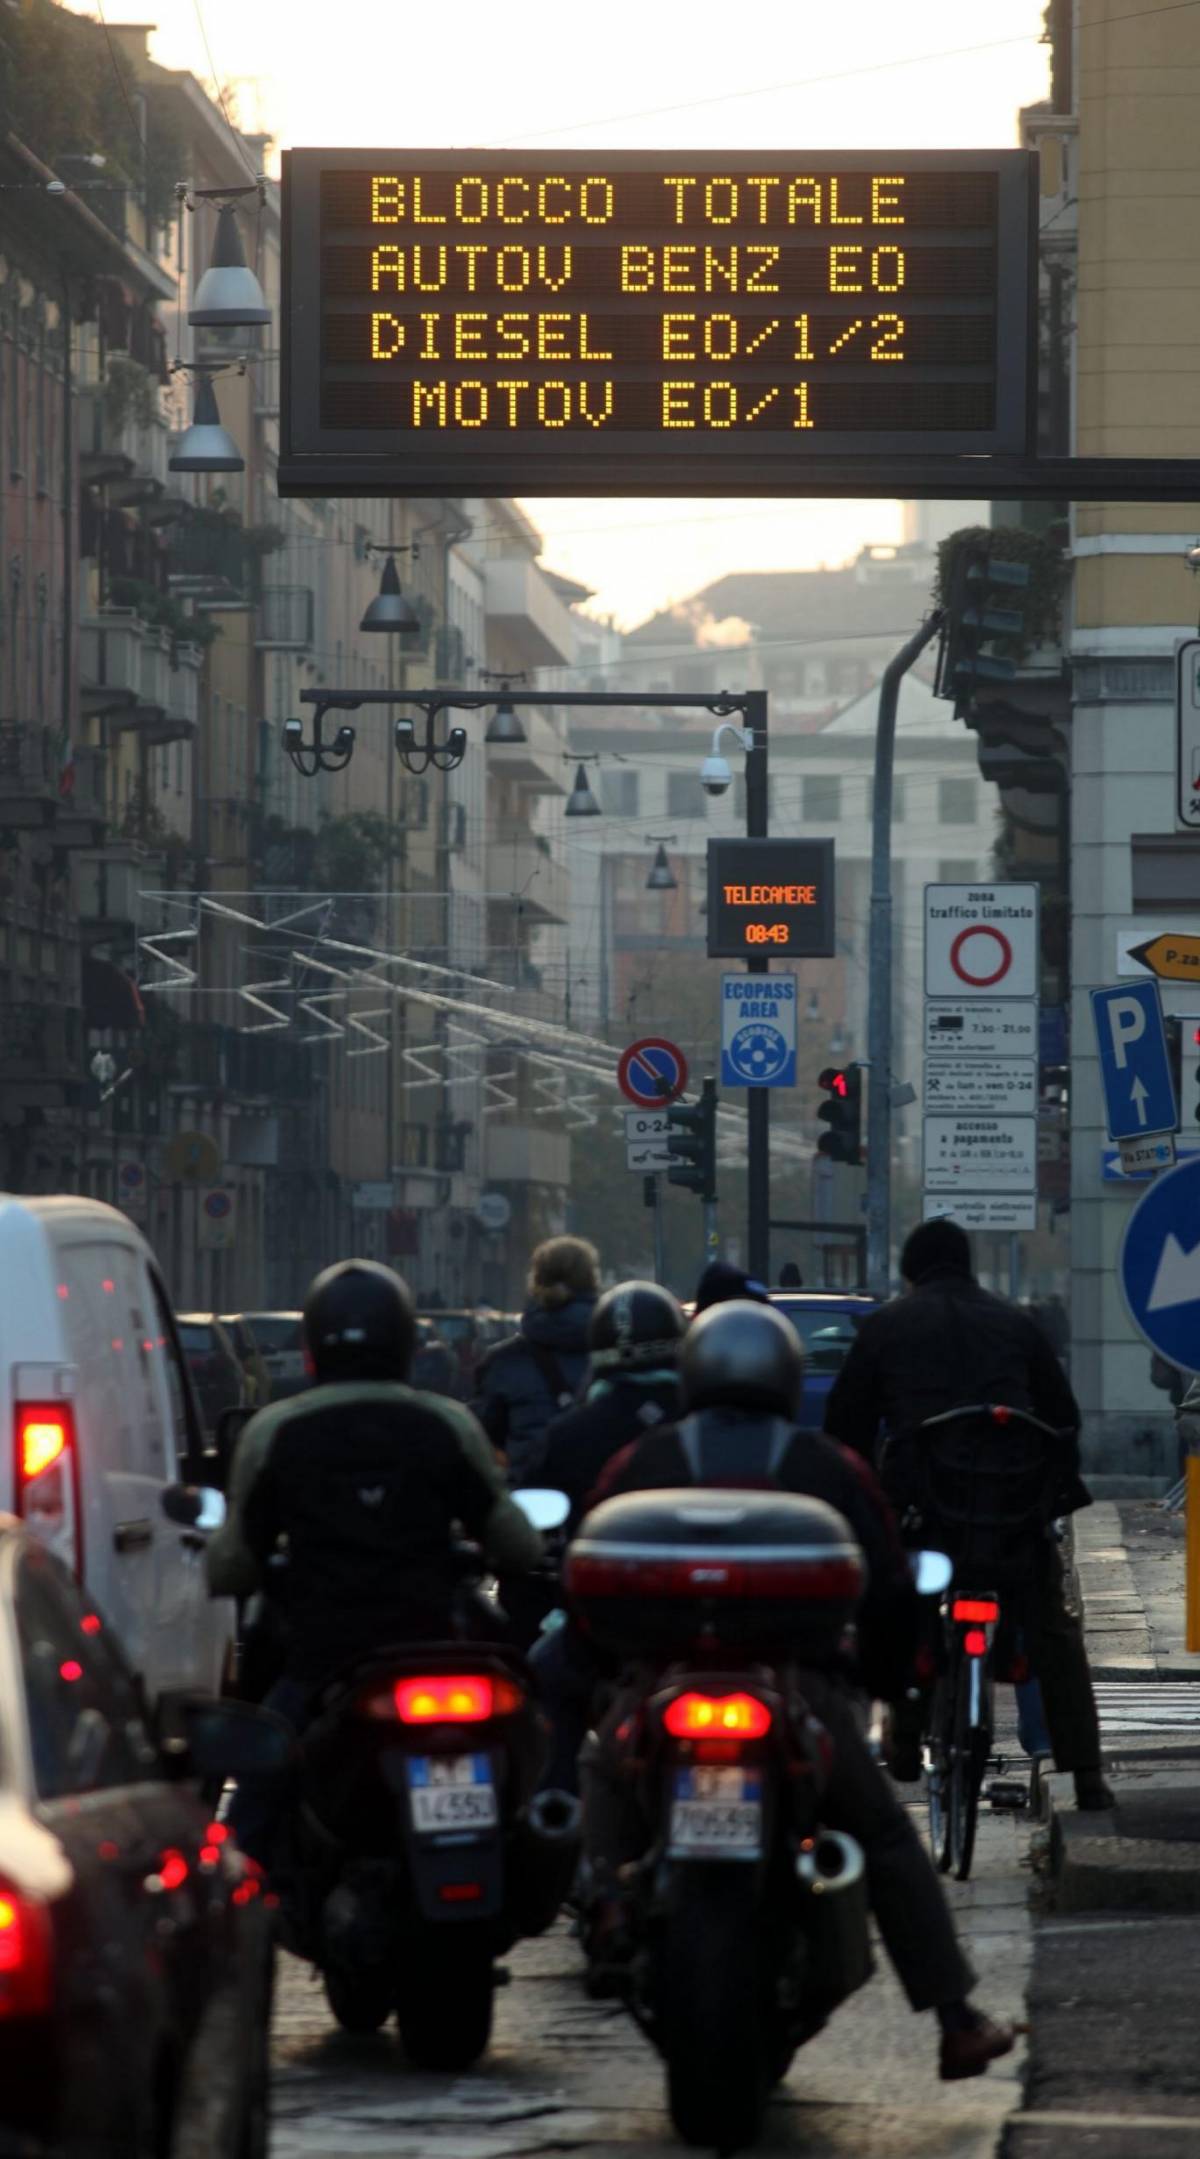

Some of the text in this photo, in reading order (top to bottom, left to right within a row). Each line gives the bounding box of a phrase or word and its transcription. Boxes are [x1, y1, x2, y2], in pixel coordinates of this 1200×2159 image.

[371, 177, 905, 224] BLOCCO TOTALE
[371, 245, 572, 292] AUTOV
[621, 245, 779, 292] BENZ
[371, 313, 612, 360] DIESEL
[413, 381, 612, 428] MOTOV
[723, 885, 817, 905] TELECAMERE
[968, 892, 995, 902] zona
[930, 906, 1033, 919] traffico limitato
[1165, 949, 1200, 967] P.za
[724, 982, 794, 1000] ECOPASS
[738, 1001, 779, 1018] AREA
[1107, 996, 1146, 1069] P
[637, 1120, 674, 1132] 0-24
[953, 1132, 1014, 1146] pagamento
